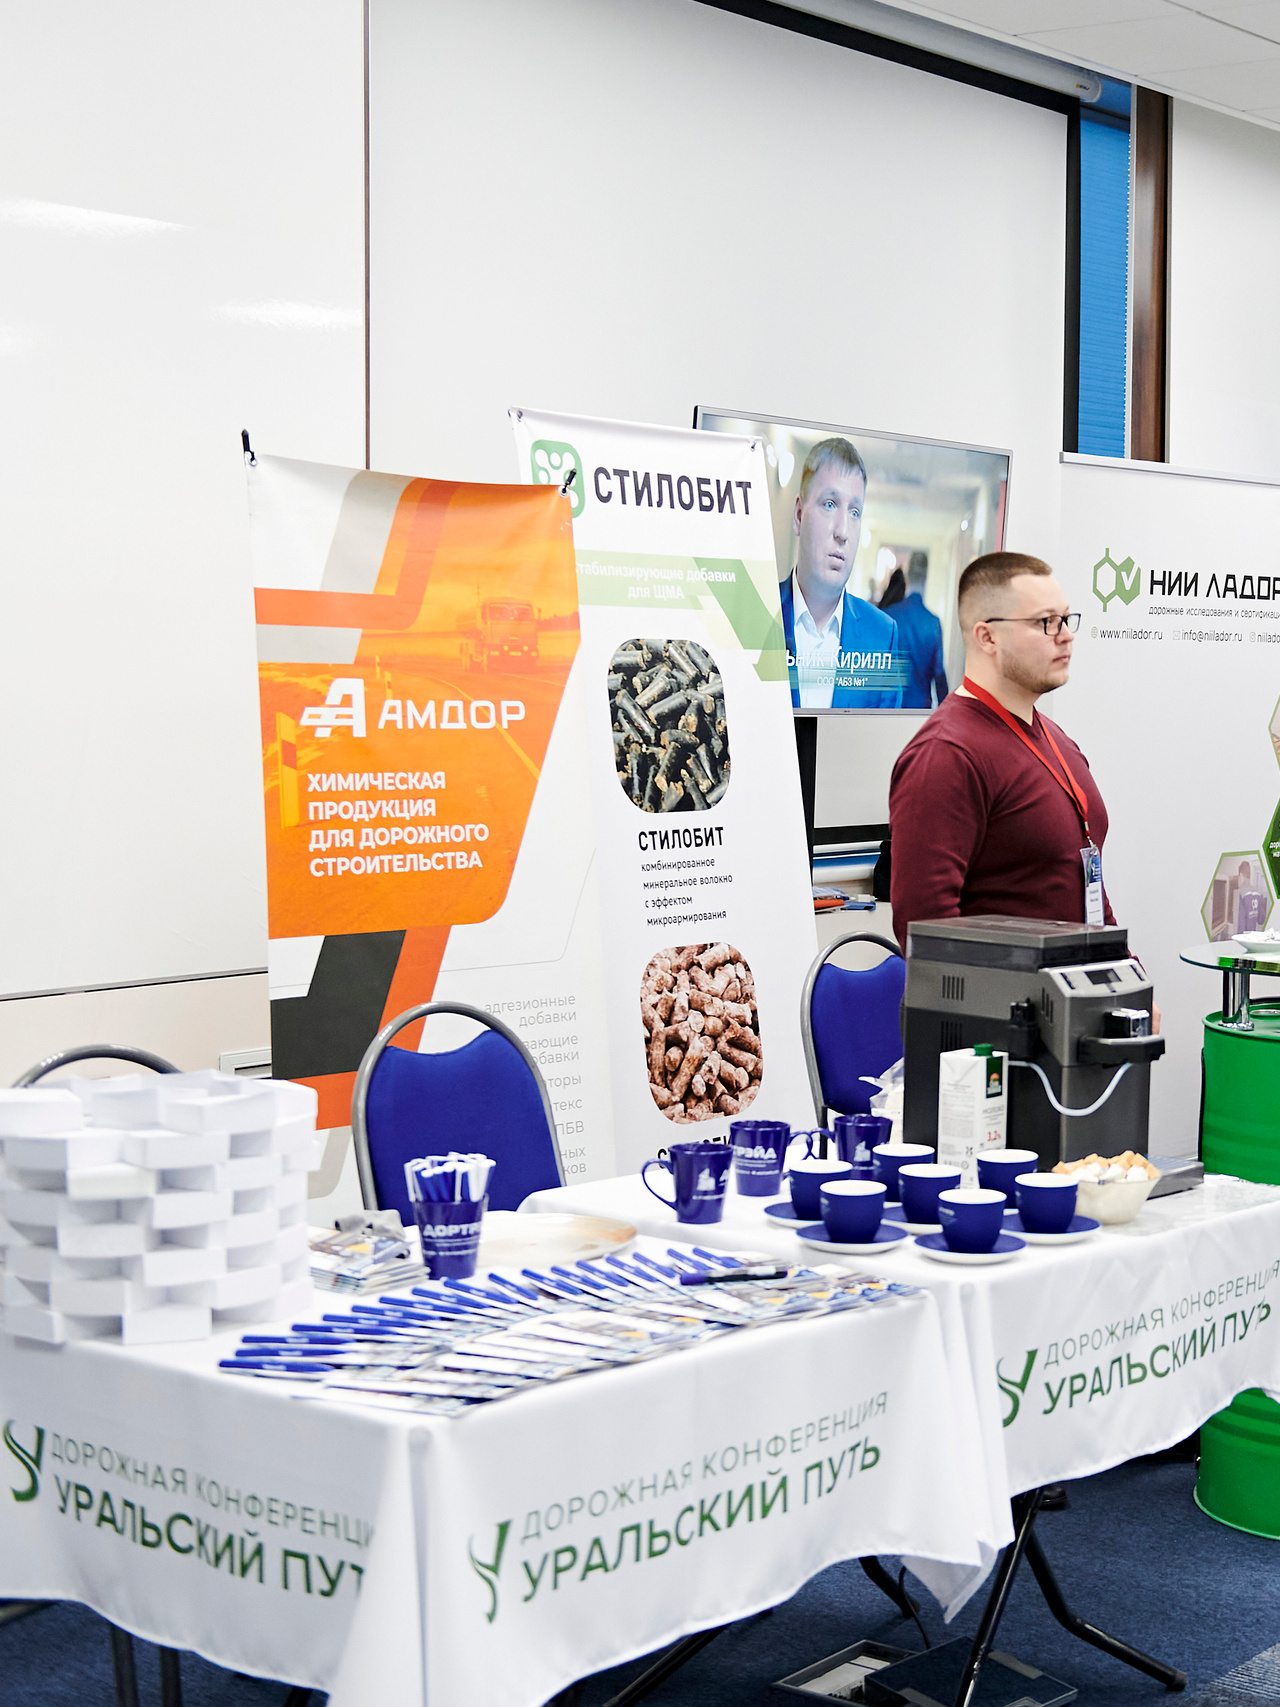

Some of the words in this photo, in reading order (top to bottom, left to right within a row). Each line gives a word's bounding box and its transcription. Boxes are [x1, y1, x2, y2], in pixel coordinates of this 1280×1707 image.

[594, 466, 753, 516] СТИЛОБИТ
[686, 568, 737, 583] добавки
[1149, 569, 1199, 597] НИИ
[628, 587, 650, 599] для
[653, 585, 685, 600] ЩМА
[1149, 606, 1184, 617] дорожные
[1186, 607, 1233, 618] исследования
[1235, 610, 1239, 618] и
[1100, 628, 1163, 640] www.niilador.ru
[1181, 629, 1243, 642] info@niilador.ru
[829, 646, 892, 673] Кирилл
[378, 700, 526, 730] АМДОР
[307, 772, 446, 793] ХИМИЧЕСКАЯ
[308, 799, 437, 823] ПРОДУКЦИЯ
[308, 829, 355, 852] ДЛЯ
[359, 823, 489, 849] ДОРОЖНОГО
[638, 826, 724, 851] СТИЛОБИТ
[309, 851, 483, 878] СТРОИТЕЛЬСТВА
[641, 858, 715, 872] комбинированное
[643, 877, 698, 891] минеральное
[700, 874, 733, 886] волокно
[644, 900, 650, 908] с
[651, 896, 693, 910] эффектом
[647, 910, 727, 927] микроармирования
[485, 995, 576, 1014] адгезионные
[519, 1011, 577, 1028] добавки
[523, 1035, 579, 1051] вающие
[532, 1051, 580, 1065] обавки
[1044, 1308, 1165, 1370] ДОРОЖНАЯ
[1042, 1316, 1217, 1416] УРАЛЬСКИЙ
[520, 1460, 694, 1546] ДОРОЖНАЯ
[700, 1390, 889, 1480] КОНФЕРЕНЦИЯ
[51, 1431, 189, 1494] ДОРОЖНАЯ
[195, 1474, 375, 1549] КОНФЕРЕНЦИ
[520, 1468, 789, 1602] УРАЛЬСКИЙ
[802, 1435, 882, 1504] ПУТЬ
[54, 1473, 266, 1584] УРАЛЬСКИЙ
[281, 1547, 366, 1598] ПУТ
